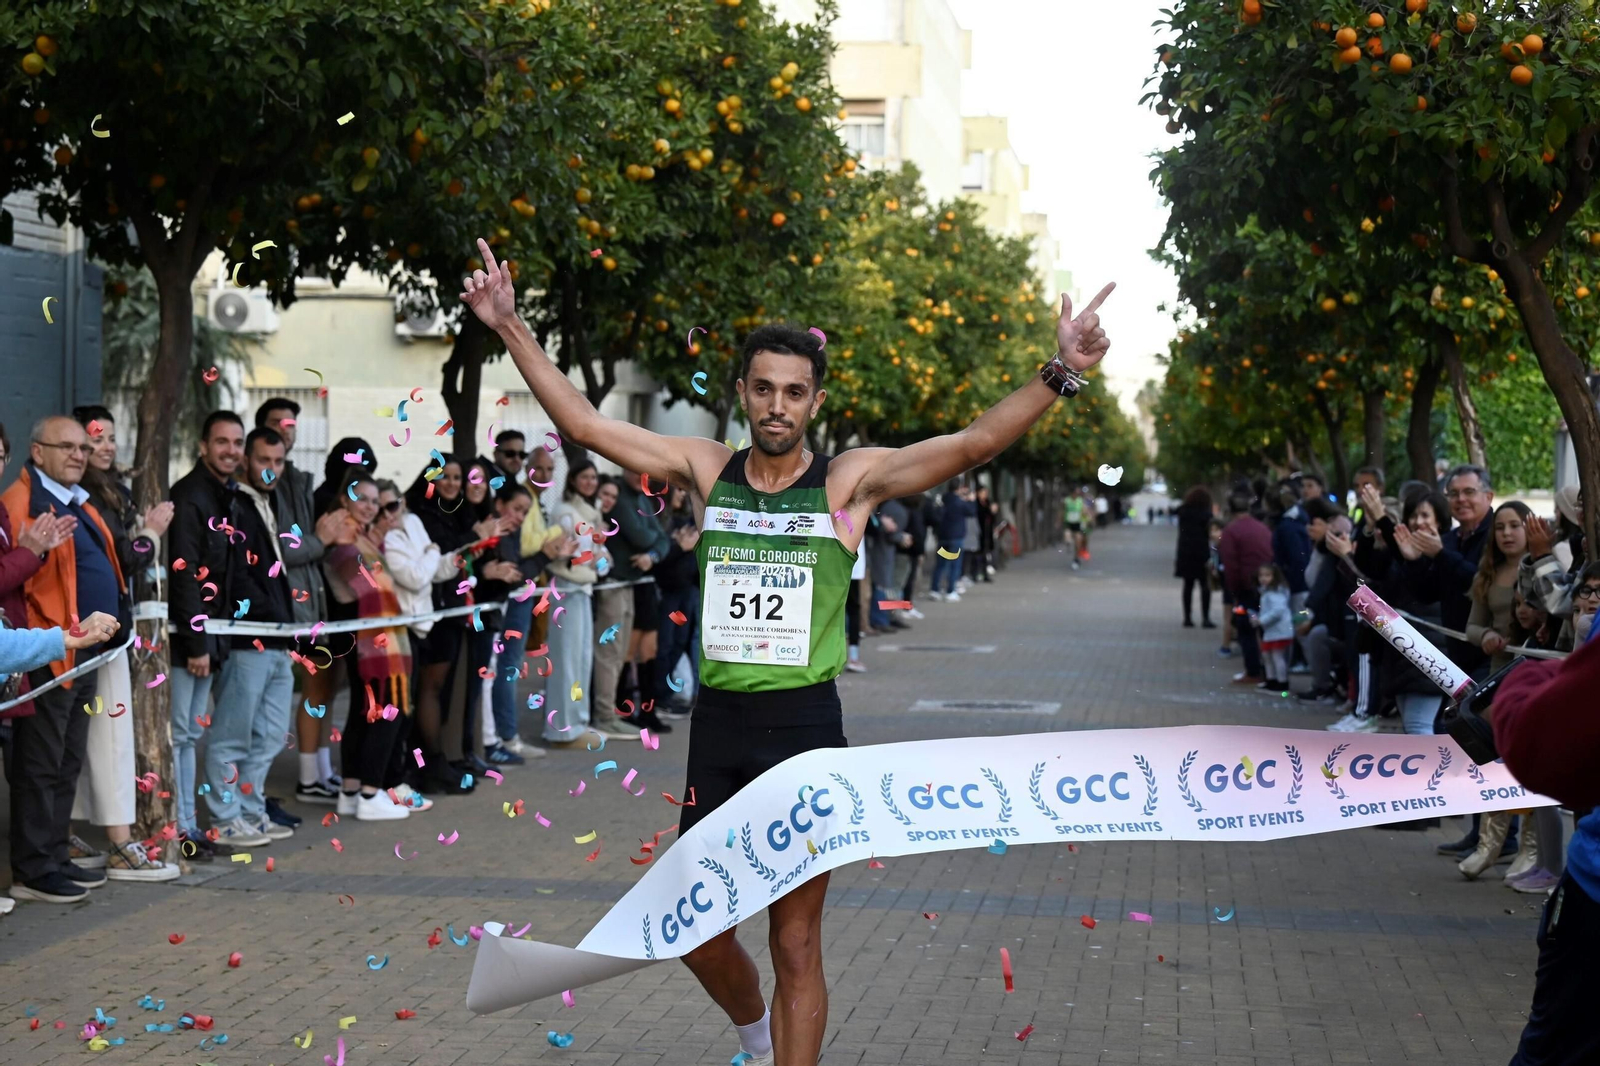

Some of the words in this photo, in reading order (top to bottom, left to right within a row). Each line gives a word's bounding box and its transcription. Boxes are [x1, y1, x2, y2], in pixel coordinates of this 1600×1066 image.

[708, 546, 756, 561] ATLETISMO
[760, 550, 818, 564] CORDOBÉS
[761, 566, 786, 576] 2024
[730, 593, 784, 620] 512
[1204, 760, 1276, 793] GCC
[1349, 754, 1426, 780] GCC
[908, 784, 984, 810] GCC
[1056, 772, 1130, 804] GCC
[1480, 784, 1526, 800] SPORT
[1340, 802, 1387, 817] SPORT
[1392, 796, 1446, 812] EVENTS
[766, 788, 834, 852] GCC
[1055, 823, 1103, 835] SPORT
[1108, 821, 1163, 833] EVENTS
[1197, 816, 1244, 830] SPORT
[1249, 810, 1304, 828] EVENTS
[906, 829, 957, 842] SPORT
[962, 827, 1020, 839] EVENTS
[770, 857, 809, 898] SPORT
[662, 882, 714, 944] GCC
